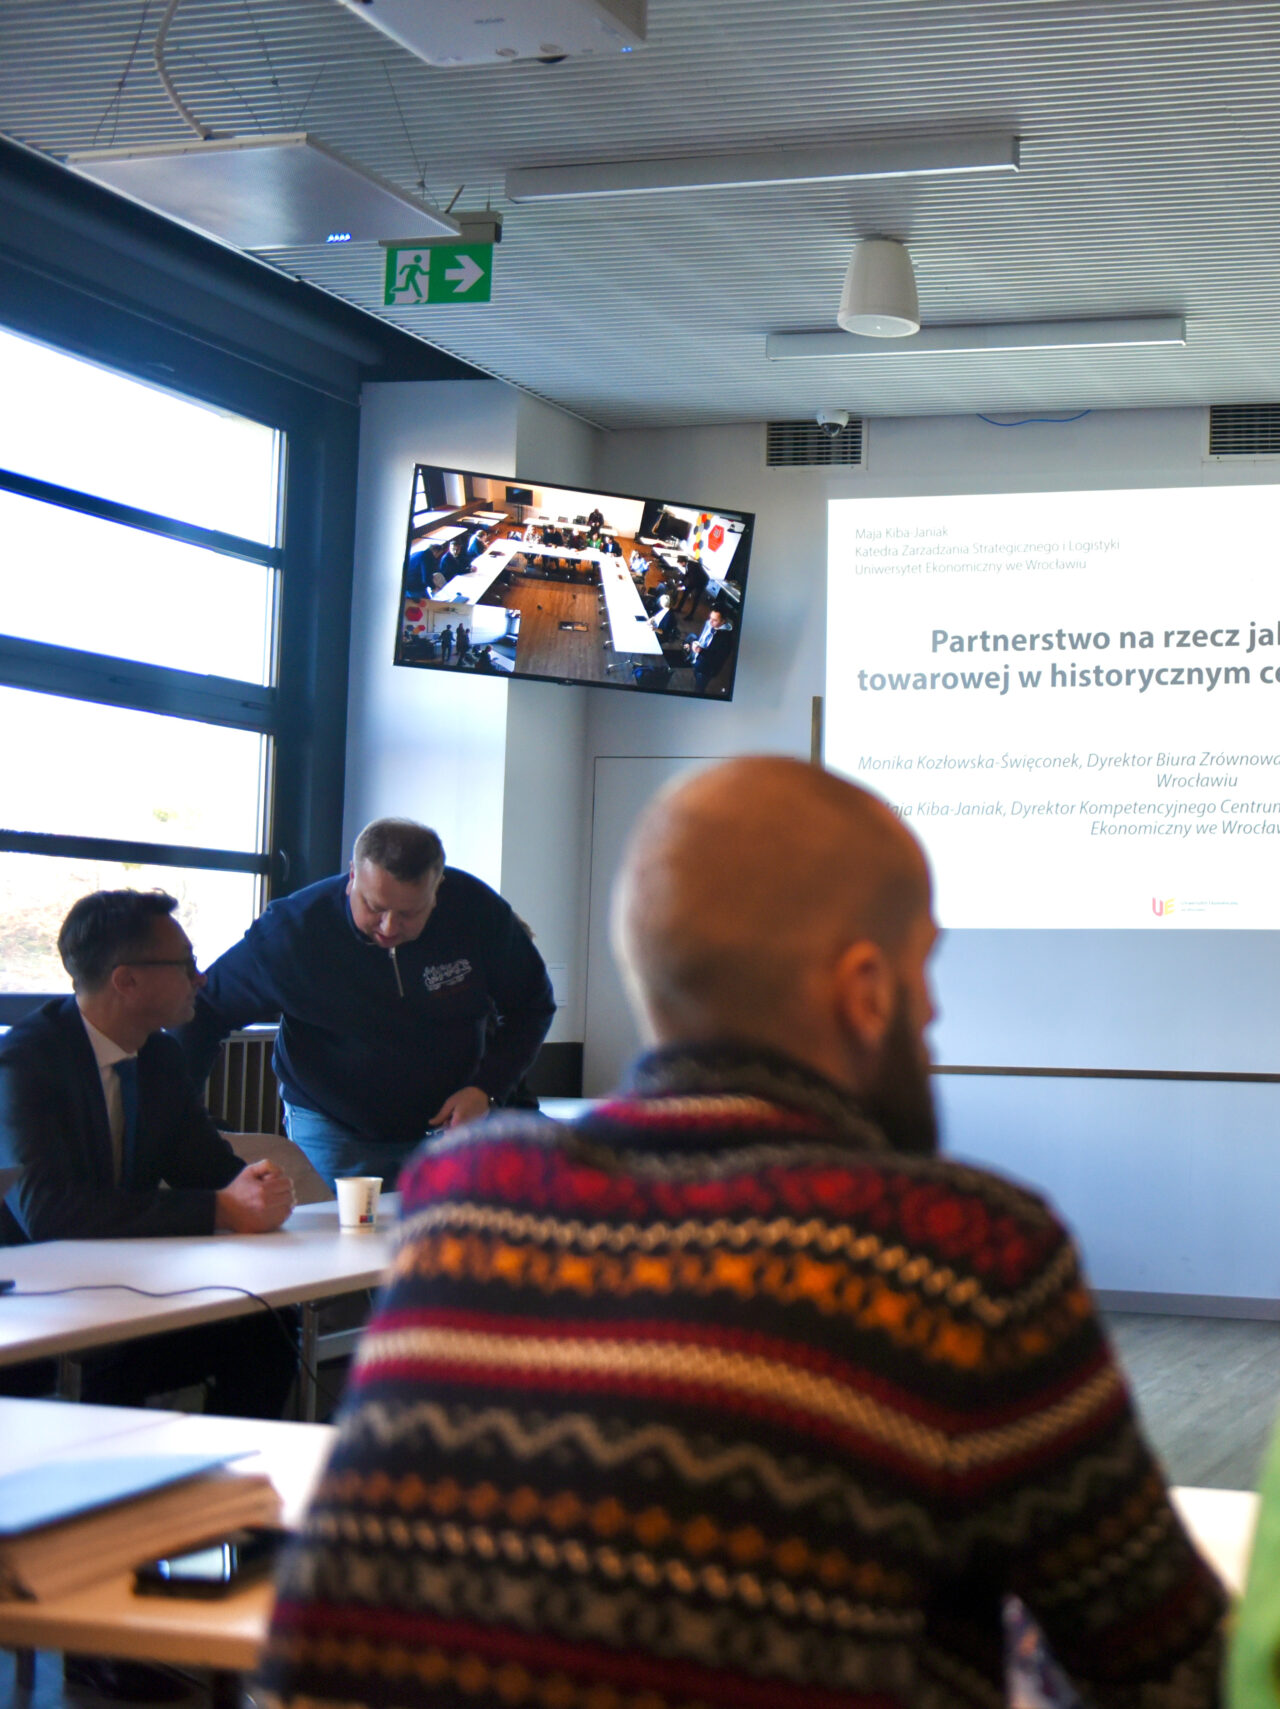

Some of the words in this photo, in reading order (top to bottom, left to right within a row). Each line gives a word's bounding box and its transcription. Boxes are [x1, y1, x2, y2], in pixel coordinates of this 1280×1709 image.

[855, 528, 882, 541] Maja
[855, 545, 898, 558] Katedra
[972, 542, 1060, 556] Strategicznego
[1069, 538, 1120, 555] Logistyki
[855, 564, 922, 576] Uniwersytet
[926, 561, 1002, 574] Ekonomiczny
[1006, 560, 1023, 571] we
[1025, 558, 1086, 570] Wrocławiu
[932, 629, 1110, 653] Partnerstwo
[1120, 631, 1154, 648] na
[1164, 629, 1240, 648] rzecz
[858, 664, 1009, 695] towarowej
[1018, 671, 1042, 688] w
[1051, 662, 1250, 693] historycznym
[858, 755, 913, 770] Monika
[917, 753, 1082, 772] Kozłowska-Święconek,
[1087, 752, 1153, 771] Dyrektor
[1156, 752, 1196, 766] Biura
[1157, 773, 1238, 788] Wrocławiu
[885, 802, 913, 820] aja
[917, 800, 1006, 816] Kiba-Janiak,
[1011, 800, 1076, 819] Dyrektor
[1080, 800, 1216, 818] Kompetencyjnego
[1091, 820, 1192, 838] Ekonomiczny
[1196, 824, 1217, 834] we
